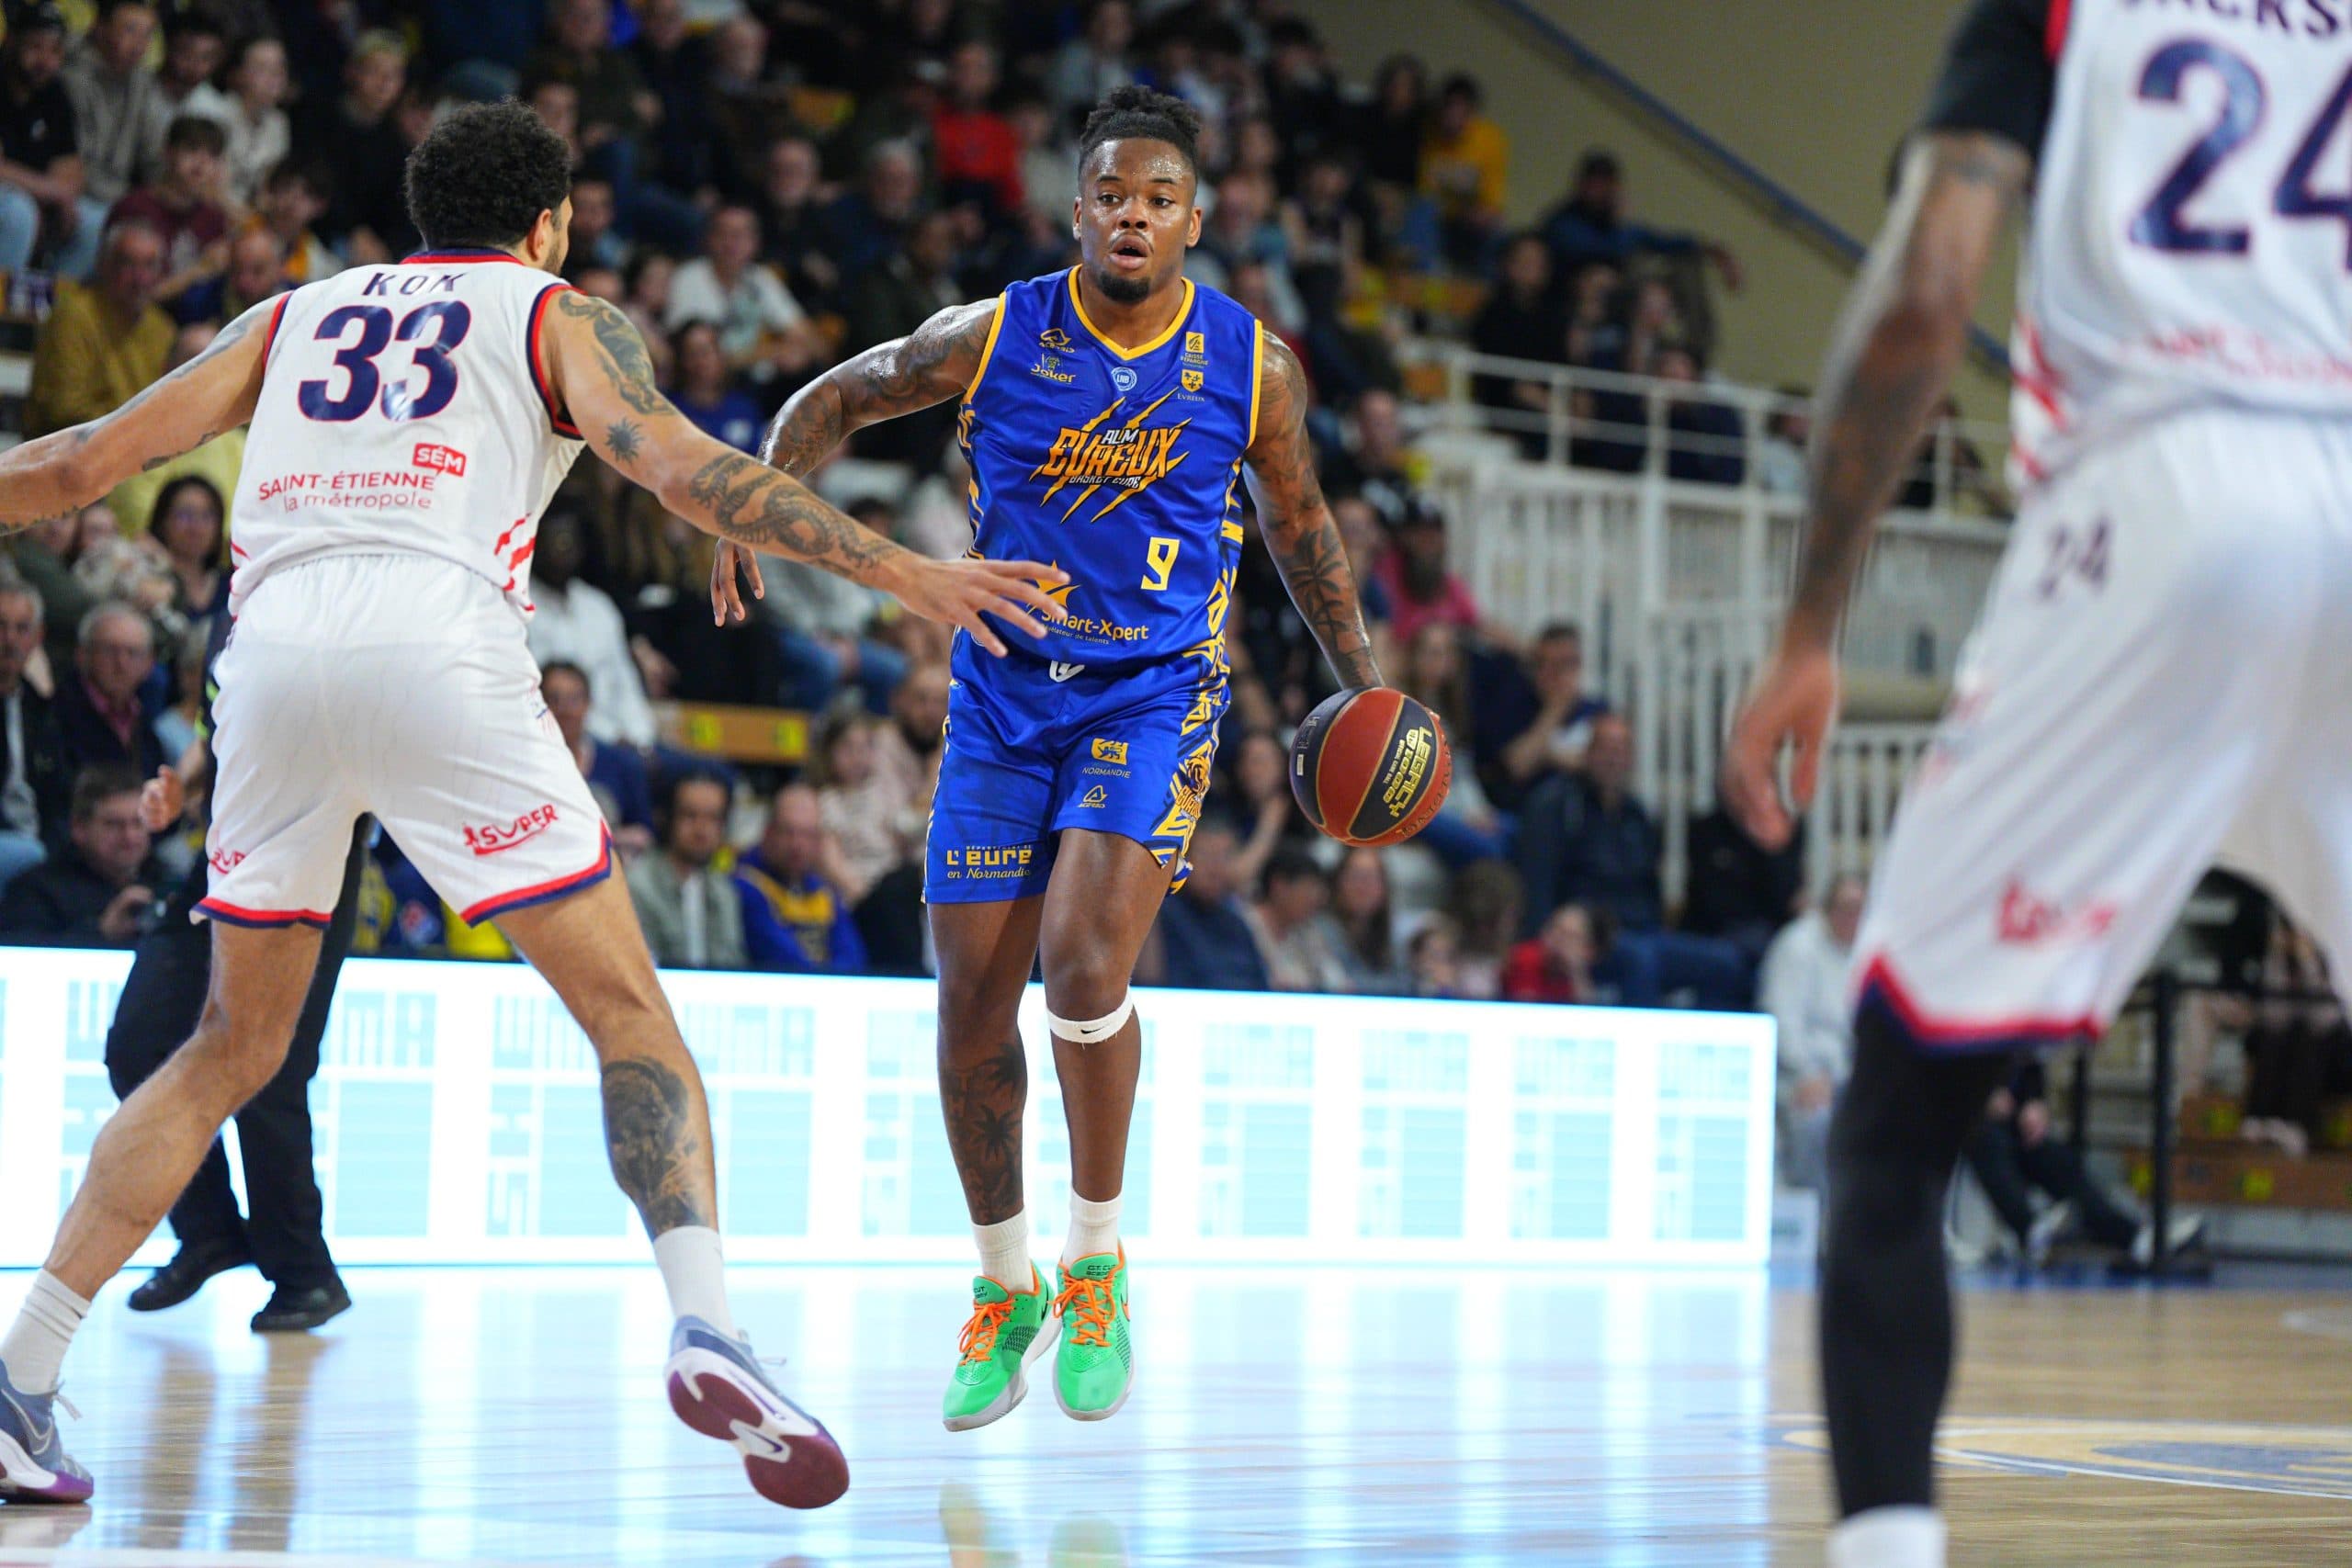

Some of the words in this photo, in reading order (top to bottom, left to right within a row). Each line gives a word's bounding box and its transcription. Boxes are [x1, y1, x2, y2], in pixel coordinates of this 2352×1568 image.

[362, 272, 467, 297] KOK
[298, 300, 471, 423] 33
[1031, 364, 1076, 383] Joker
[1116, 374, 1130, 384] LNB
[1102, 429, 1139, 445] ALM
[416, 446, 463, 472] SÉM
[258, 470, 435, 501] SAINT-ÉTIENNE
[284, 495, 298, 512] la
[304, 491, 432, 511] métropole
[1140, 536, 1181, 591] 9
[1082, 767, 1131, 778] NORMANDIE
[1389, 727, 1432, 818] LEGACY
[480, 804, 559, 845] SUPER
[947, 871, 961, 879] en
[967, 867, 1031, 879] Normandie
